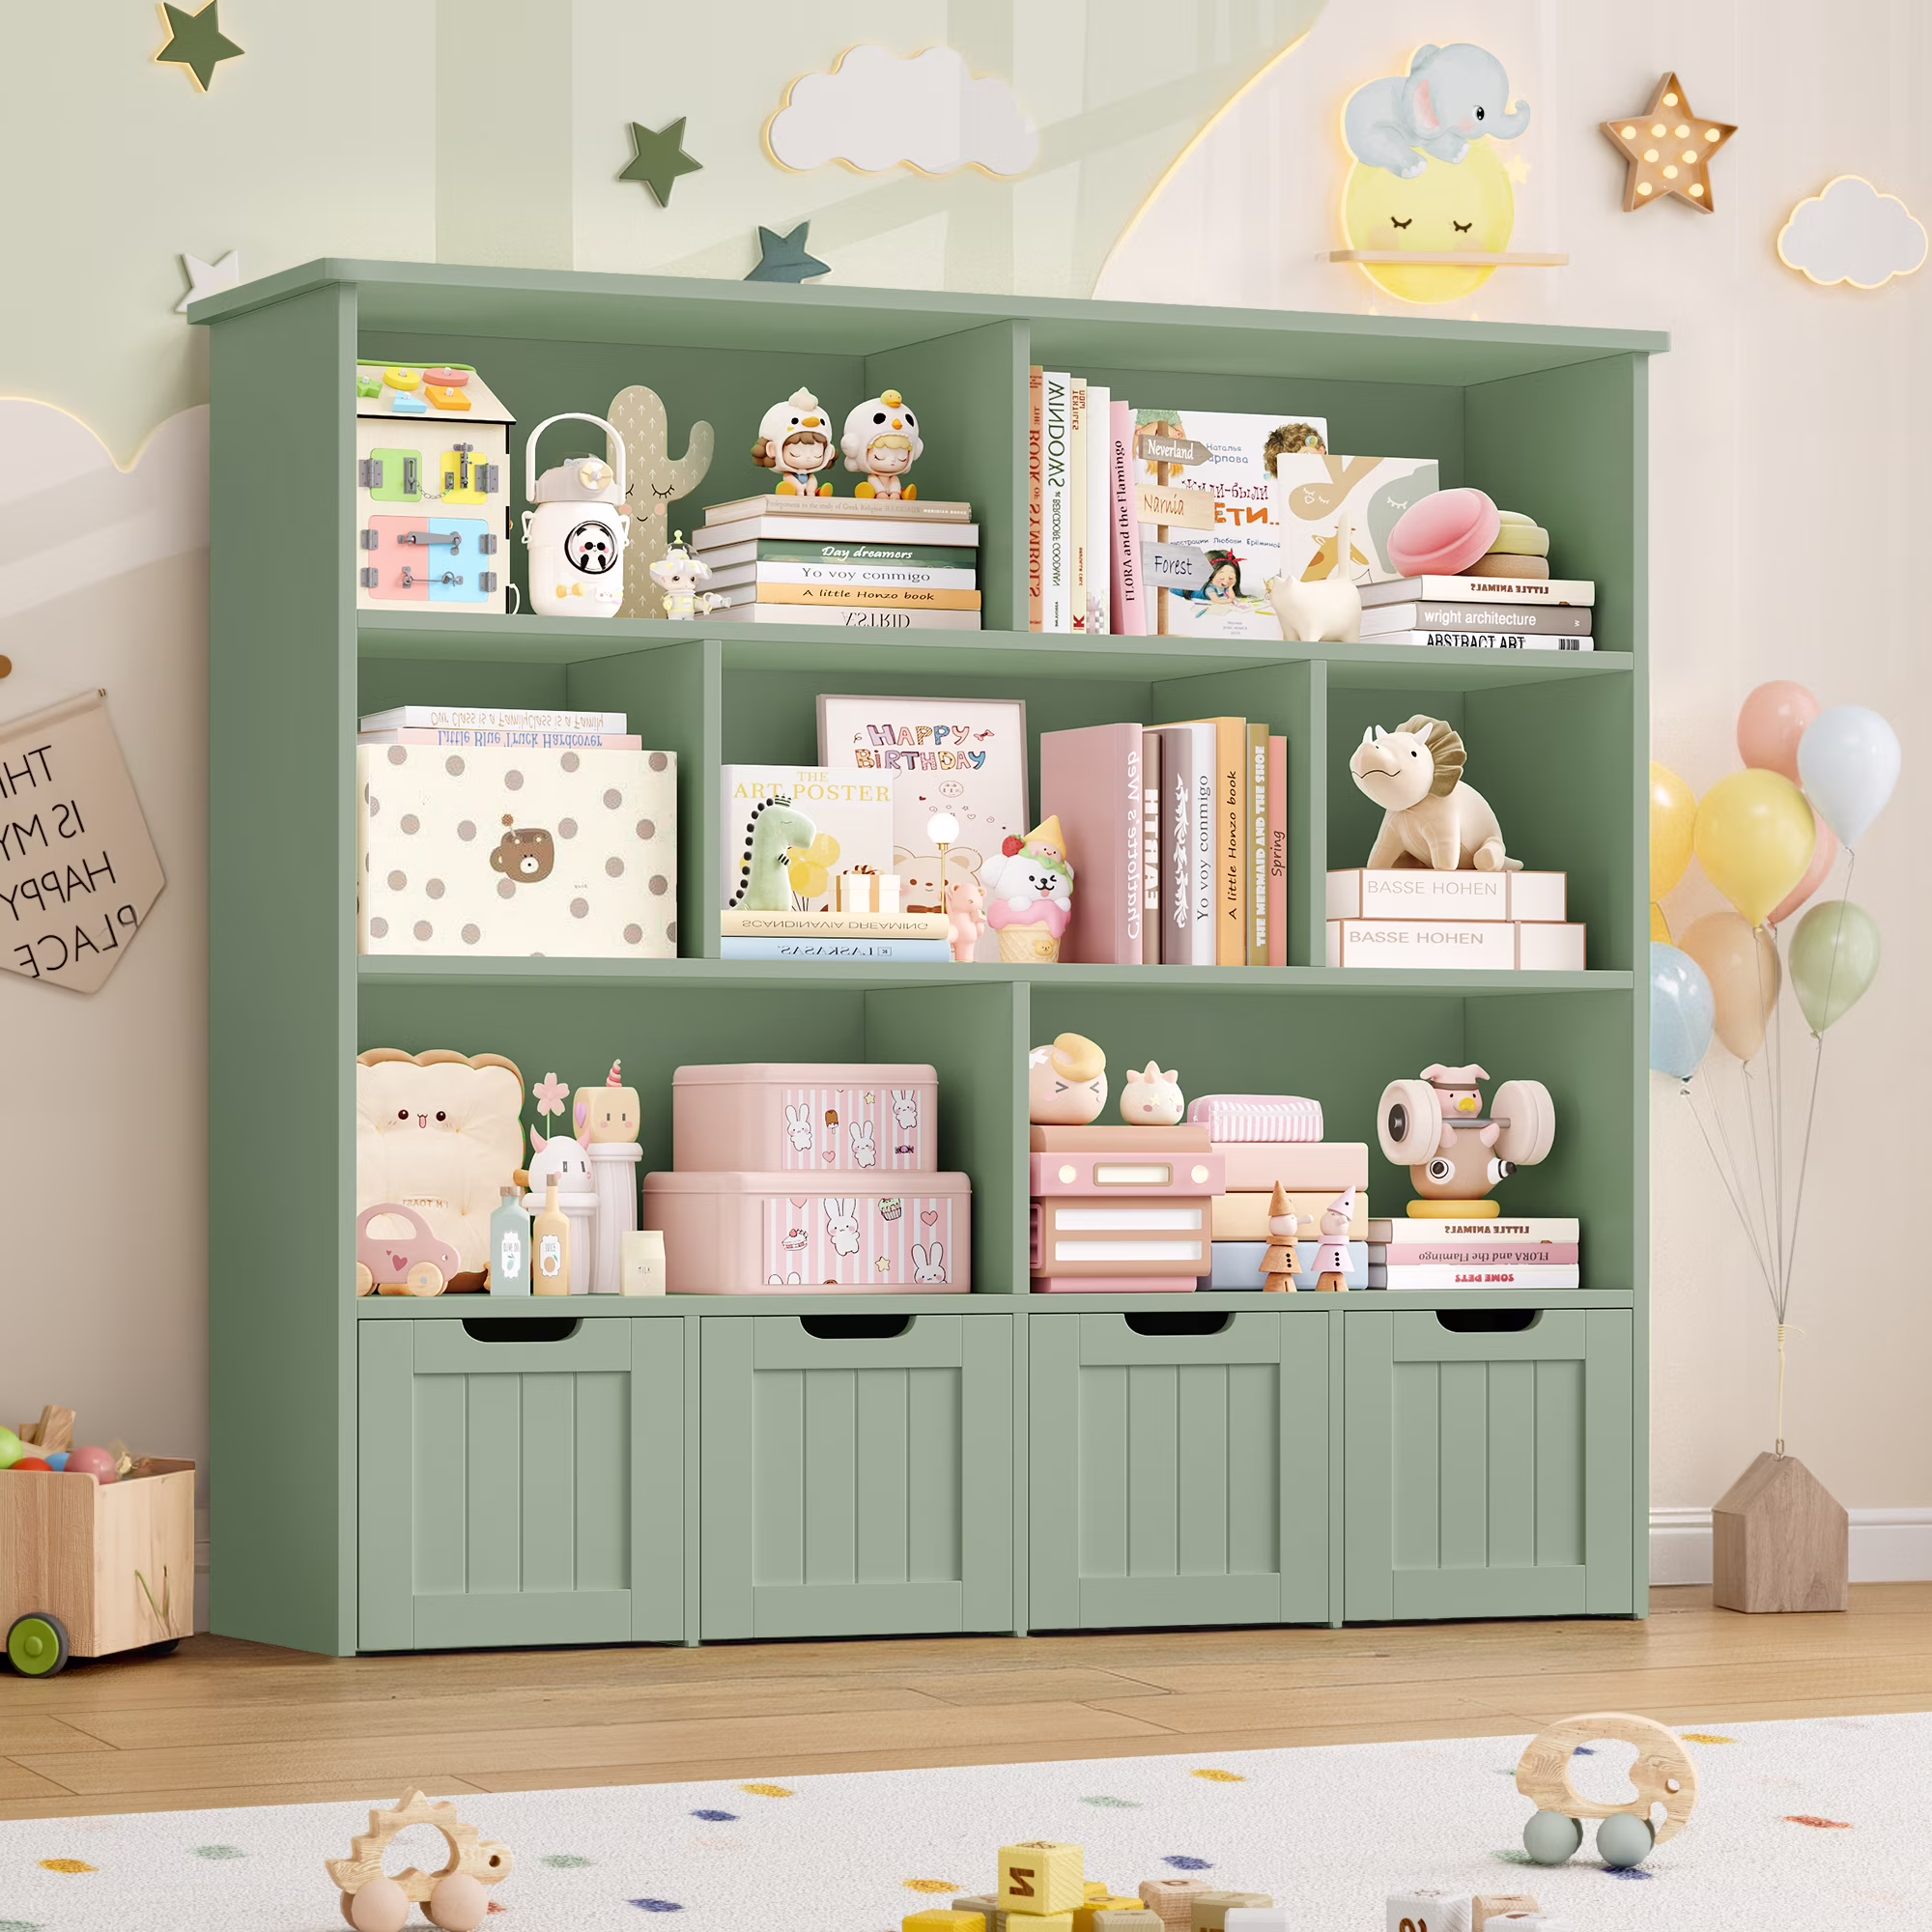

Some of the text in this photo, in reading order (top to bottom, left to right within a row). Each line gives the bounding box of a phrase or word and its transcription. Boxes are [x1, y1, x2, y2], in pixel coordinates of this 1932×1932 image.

[1148, 439, 1194, 460] Neverland
[1206, 443, 1241, 452] Наталья
[1208, 454, 1249, 465] арпова
[1115, 440, 1135, 602] FLORA and the Flamingo
[821, 545, 913, 561] Day dreamers
[1154, 555, 1193, 576] Forest
[802, 567, 930, 583] Yo voy conmigo
[819, 588, 852, 598] little
[857, 590, 898, 600] Honzo
[904, 591, 935, 601] book
[1424, 610, 1537, 626] wright architecture
[1427, 634, 1526, 649] ABSTRACT ART
[867, 724, 970, 747] HAPPY
[797, 771, 829, 782] THE
[733, 782, 892, 802] ART POSTER
[1197, 775, 1211, 921] Yo voy conmigo
[1227, 770, 1237, 920] A little Honzo book
[1254, 745, 1266, 947] THE MERMAID AND THE SHOE
[1270, 831, 1286, 876] Spring
[1367, 881, 1497, 895] BASSE HOHEN
[1350, 931, 1484, 944] BASSE HOHEN
[1418, 1251, 1549, 1262] FLORA and the Flamingo
[1455, 1274, 1515, 1283] SOME PETS
